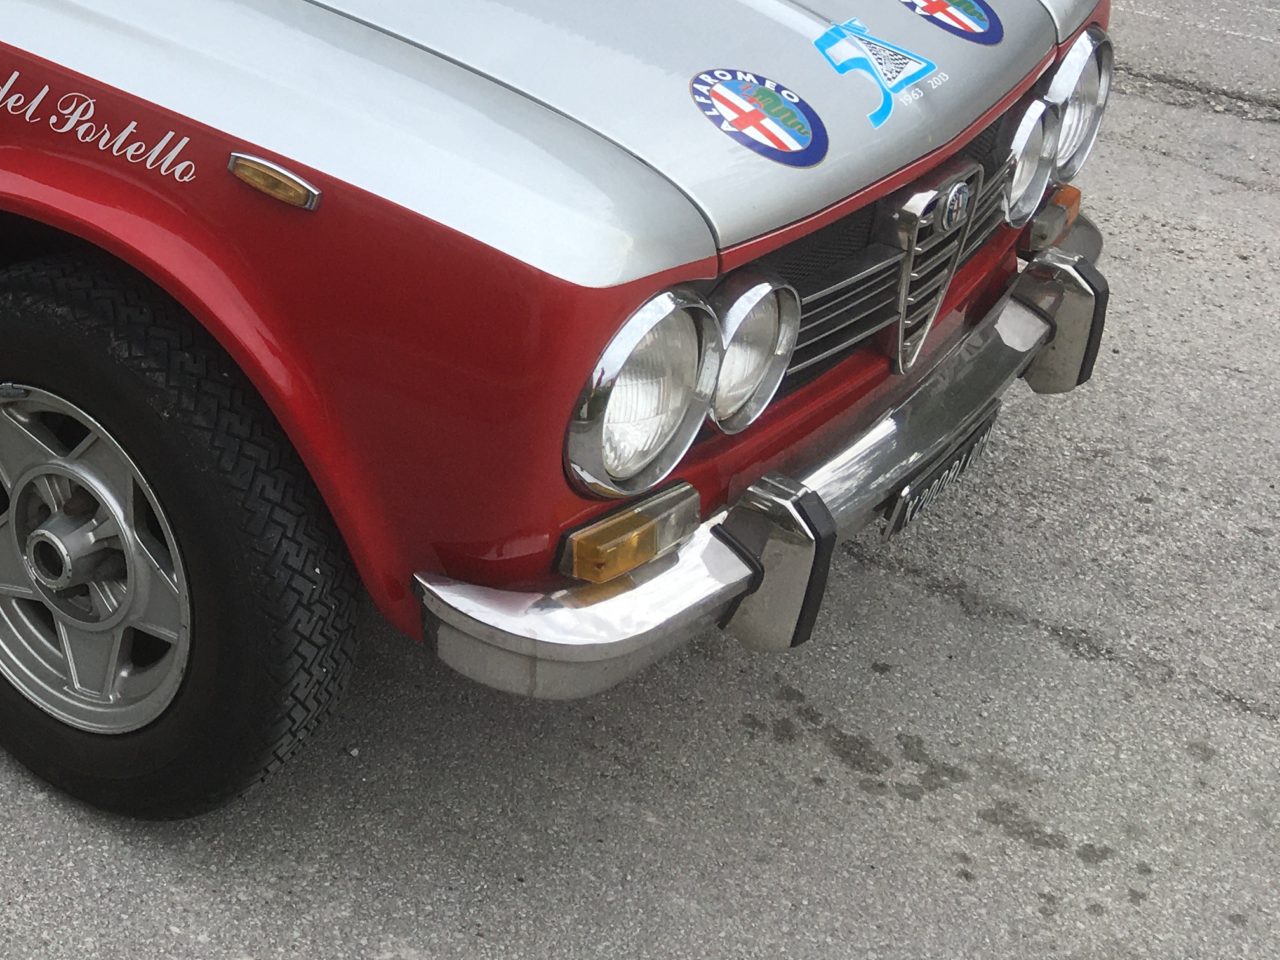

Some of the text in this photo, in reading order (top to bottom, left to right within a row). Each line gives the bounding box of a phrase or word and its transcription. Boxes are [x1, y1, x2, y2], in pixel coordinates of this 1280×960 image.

[899, 71, 950, 108] 1963 2013
[49, 92, 196, 182] Portello
